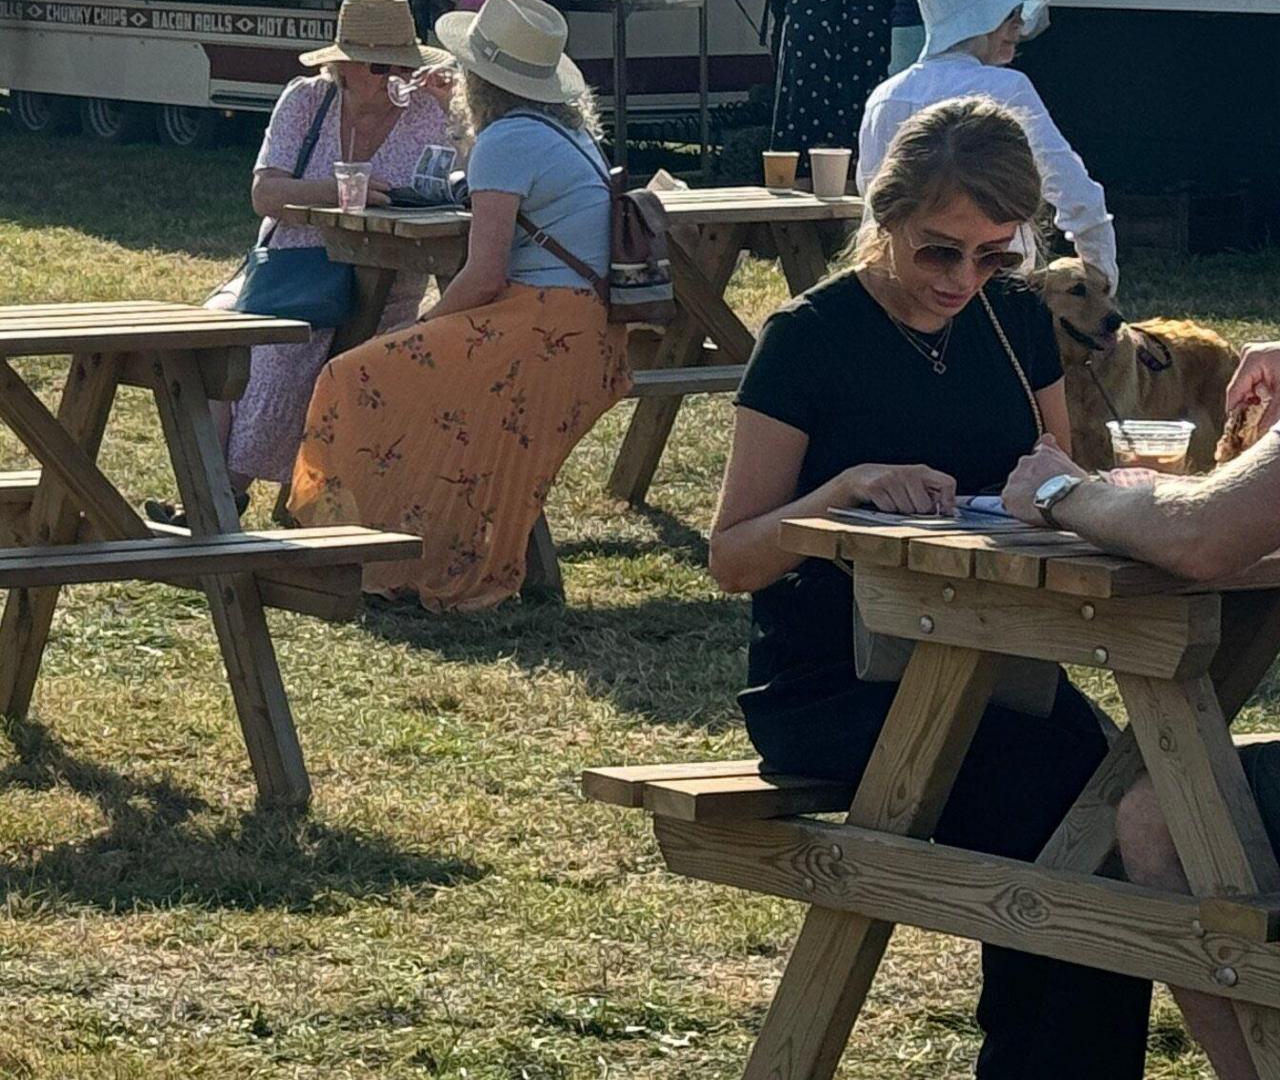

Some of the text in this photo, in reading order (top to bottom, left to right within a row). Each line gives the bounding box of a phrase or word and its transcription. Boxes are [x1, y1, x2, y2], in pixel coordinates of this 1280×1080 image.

[45, 3, 93, 25] CHUNKY
[93, 7, 128, 26] CHIPS
[151, 10, 192, 30] BACON
[194, 13, 233, 32] ROLLS
[256, 16, 283, 36] HOT
